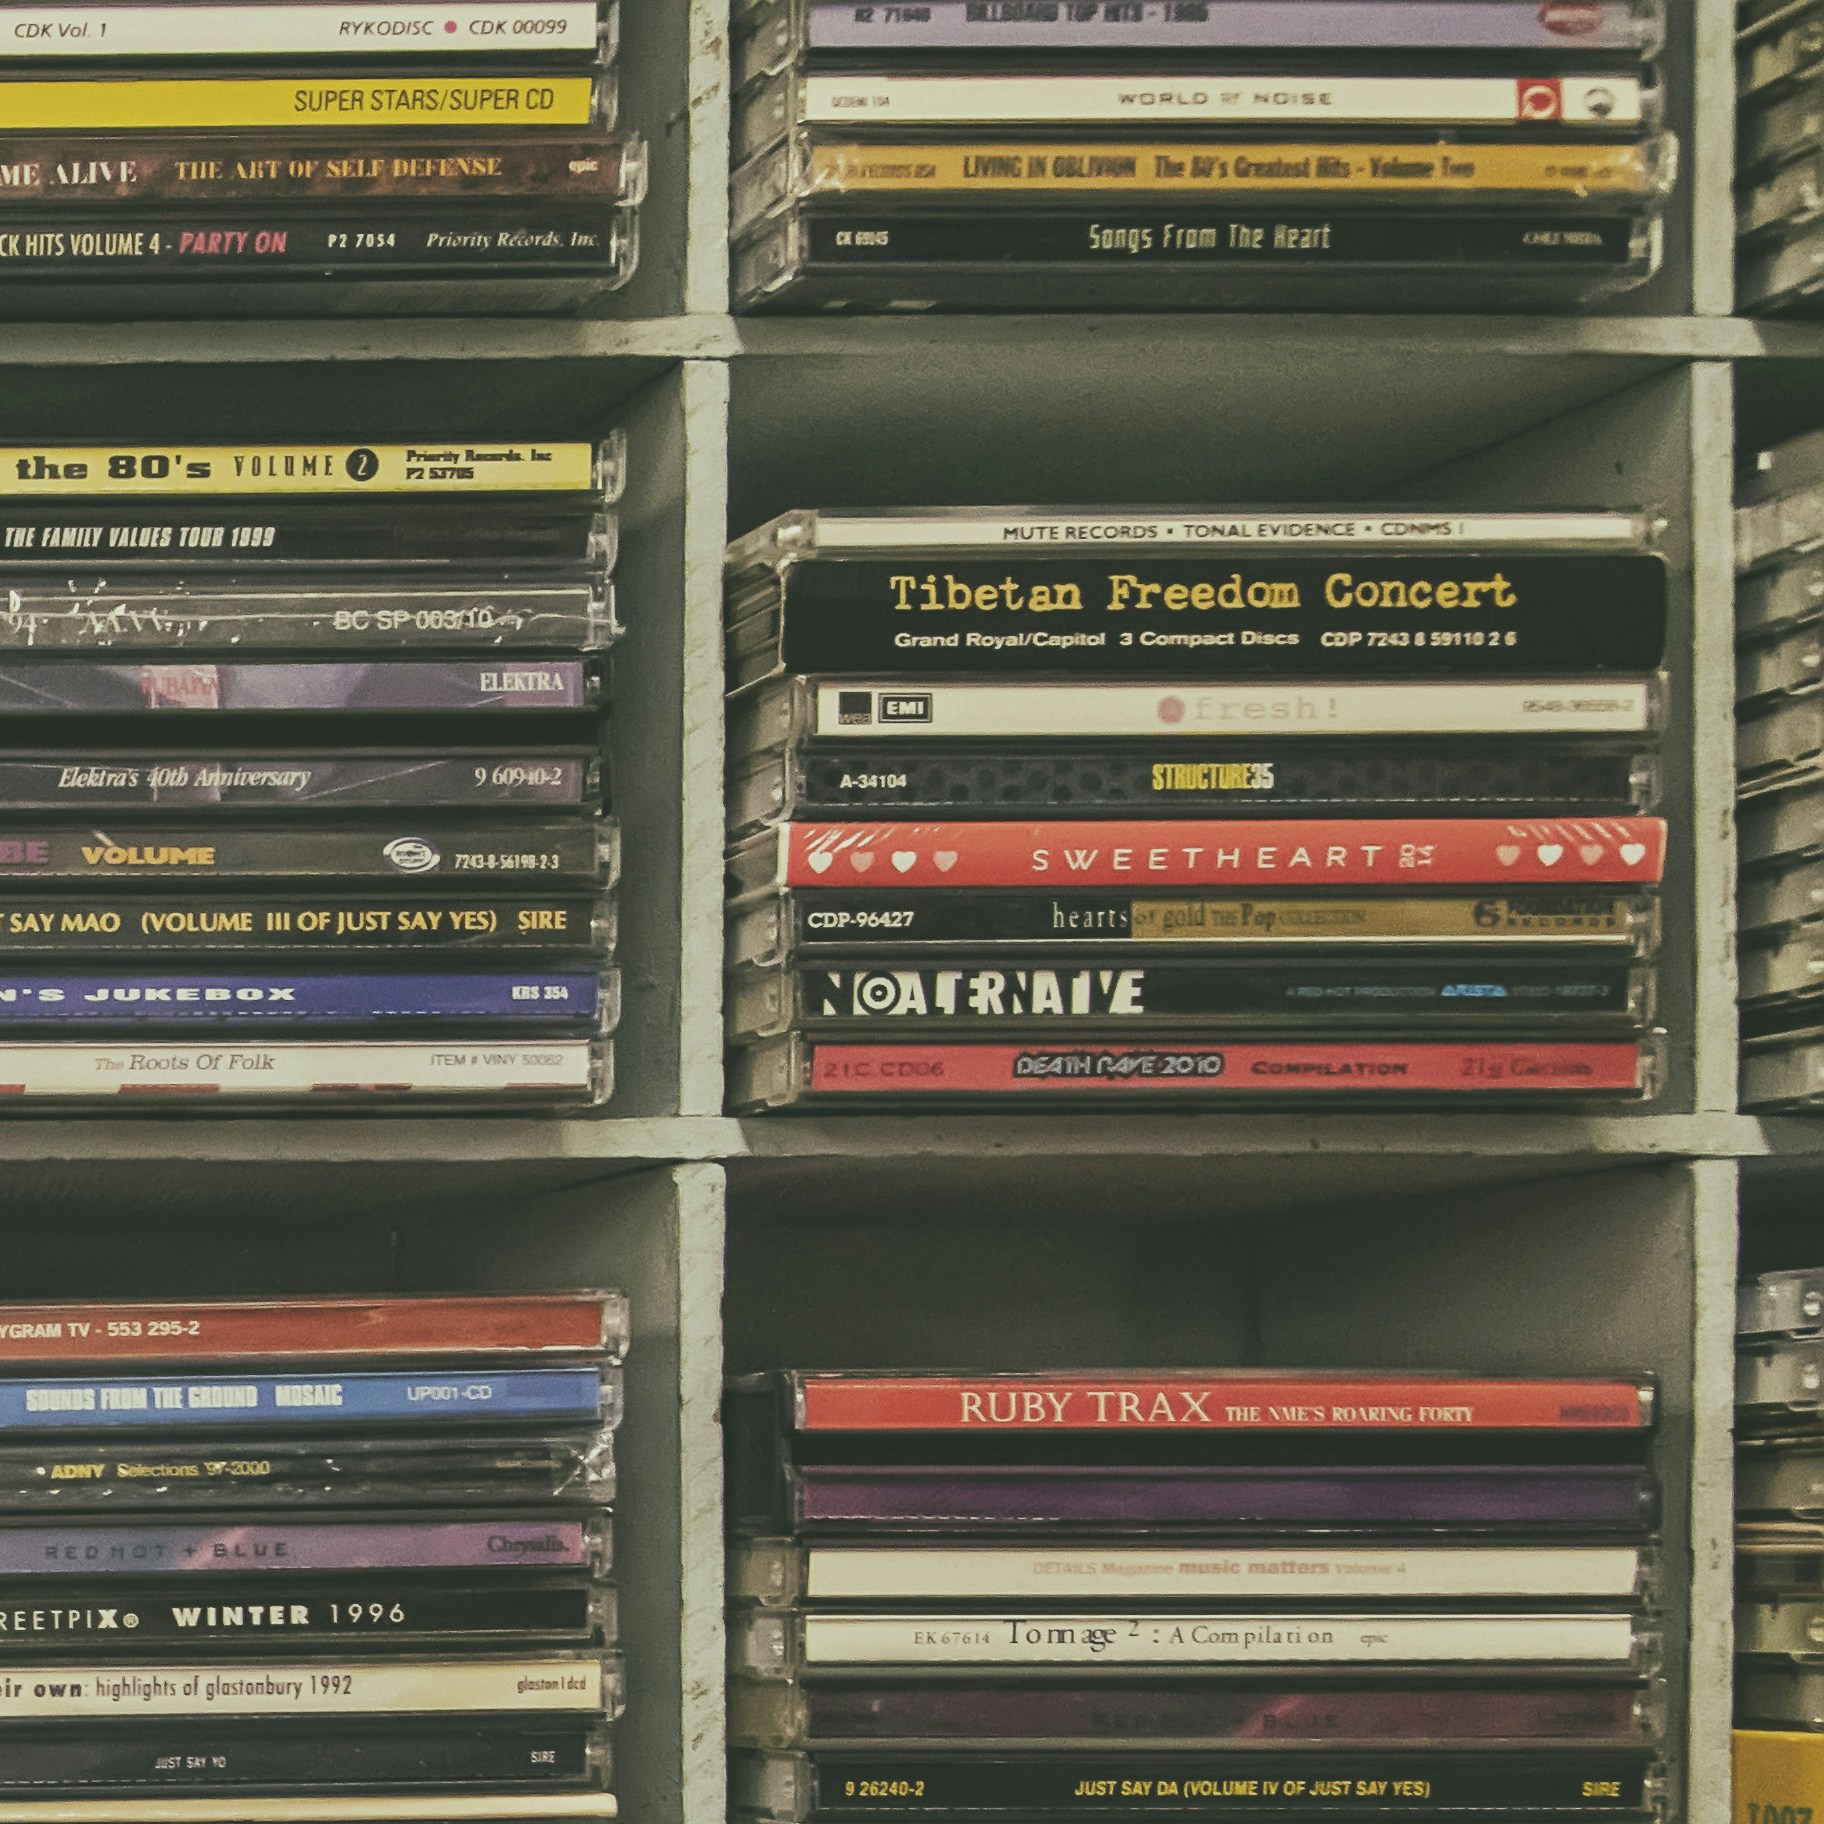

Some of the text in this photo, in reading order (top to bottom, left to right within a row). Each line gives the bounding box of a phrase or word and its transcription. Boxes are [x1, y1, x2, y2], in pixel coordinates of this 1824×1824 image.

[293, 89, 364, 113] SUPER
[371, 88, 517, 112] STARS/SUPER
[525, 88, 555, 111] CD
[1088, 224, 1331, 253] Songs From The Heart
[15, 455, 88, 480] the
[108, 454, 211, 480] 80's
[233, 454, 333, 477] VOLUME
[890, 572, 1517, 612] Tibetan Freedom Concert
[885, 698, 927, 720] EMI
[839, 773, 907, 789] A-34104
[807, 910, 915, 929] CDP-96427
[84, 987, 295, 1002] JUKEBOX
[960, 1391, 1473, 1425] RUBY TRAX THE NME'S ROARING FORTY
[95, 1675, 177, 1702] highlights
[182, 1676, 200, 1697] of
[206, 1675, 302, 1702] glastonbury
[310, 1673, 353, 1695] 1992
